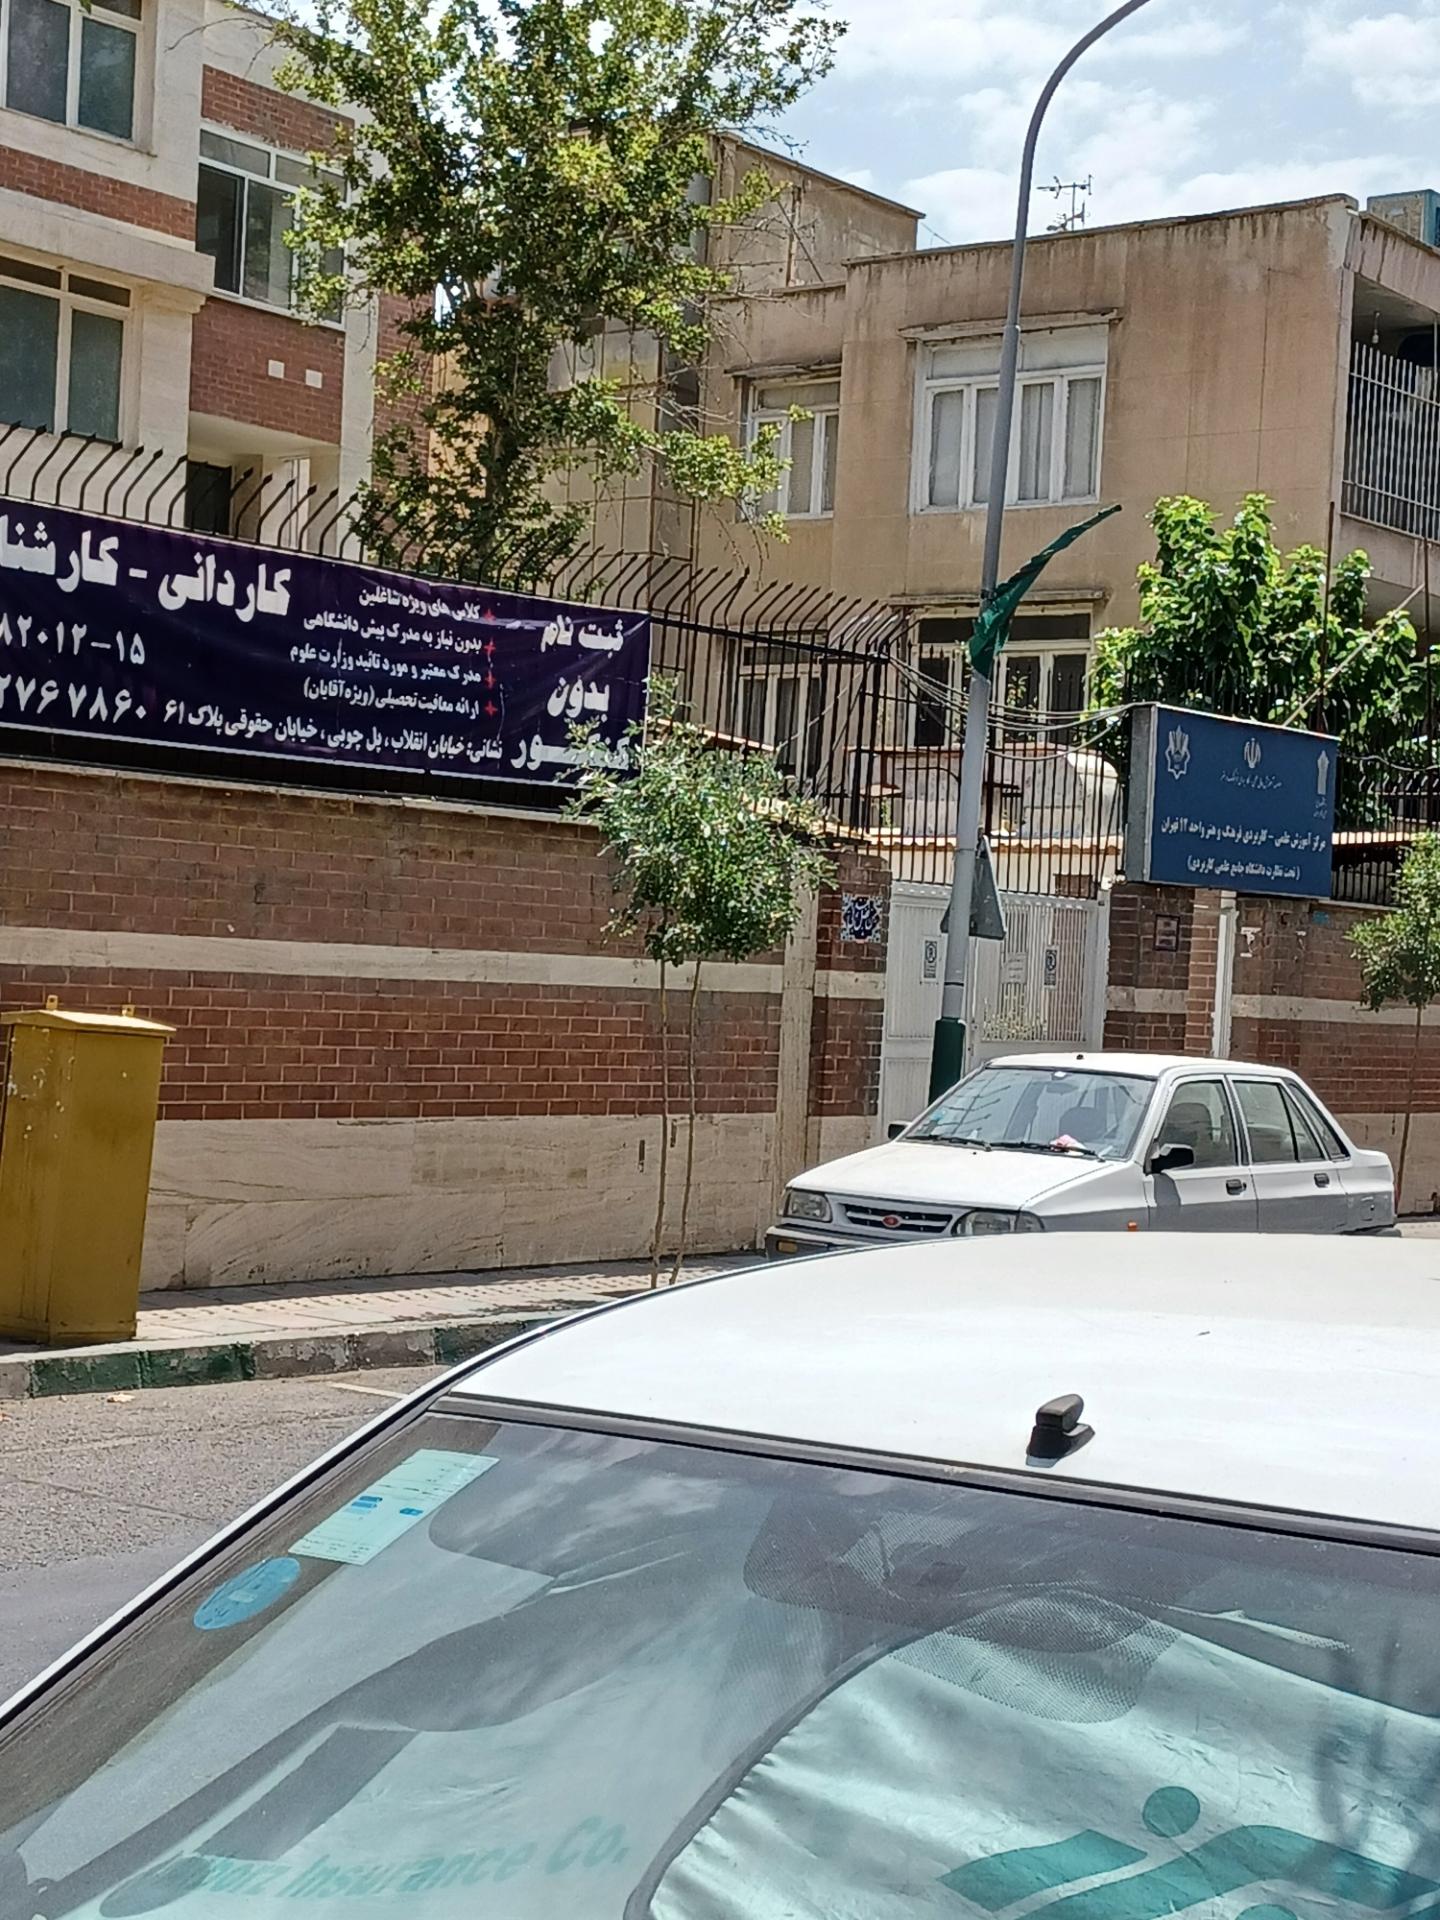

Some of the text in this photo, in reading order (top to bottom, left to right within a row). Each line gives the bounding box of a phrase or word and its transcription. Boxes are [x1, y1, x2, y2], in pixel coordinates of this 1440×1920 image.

[158, 552, 291, 623] کاردانی
[402, 597, 427, 616] ویژه
[428, 599, 451, 617] های
[452, 602, 480, 621] کلاس
[303, 611, 482, 655] بدون نیاز به مدرک پیش دانشگاهی
[540, 614, 624, 659] ثبت نام
[290, 642, 317, 664] علوم
[318, 648, 354, 671] وزارت
[384, 657, 409, 677] مورد
[412, 664, 418, 679] و
[420, 664, 446, 680] معتبر
[449, 665, 481, 686] مدرک
[374, 688, 417, 709] تحصیلی
[418, 693, 453, 714] معافیت
[547, 676, 610, 723] بدون
[188, 704, 224, 736] پلاک
[224, 708, 273, 739] حقوقی
[274, 715, 318, 743] خیابان
[366, 726, 382, 754] پل
[427, 734, 465, 760] خیابان
[466, 738, 503, 764] نشانی:
